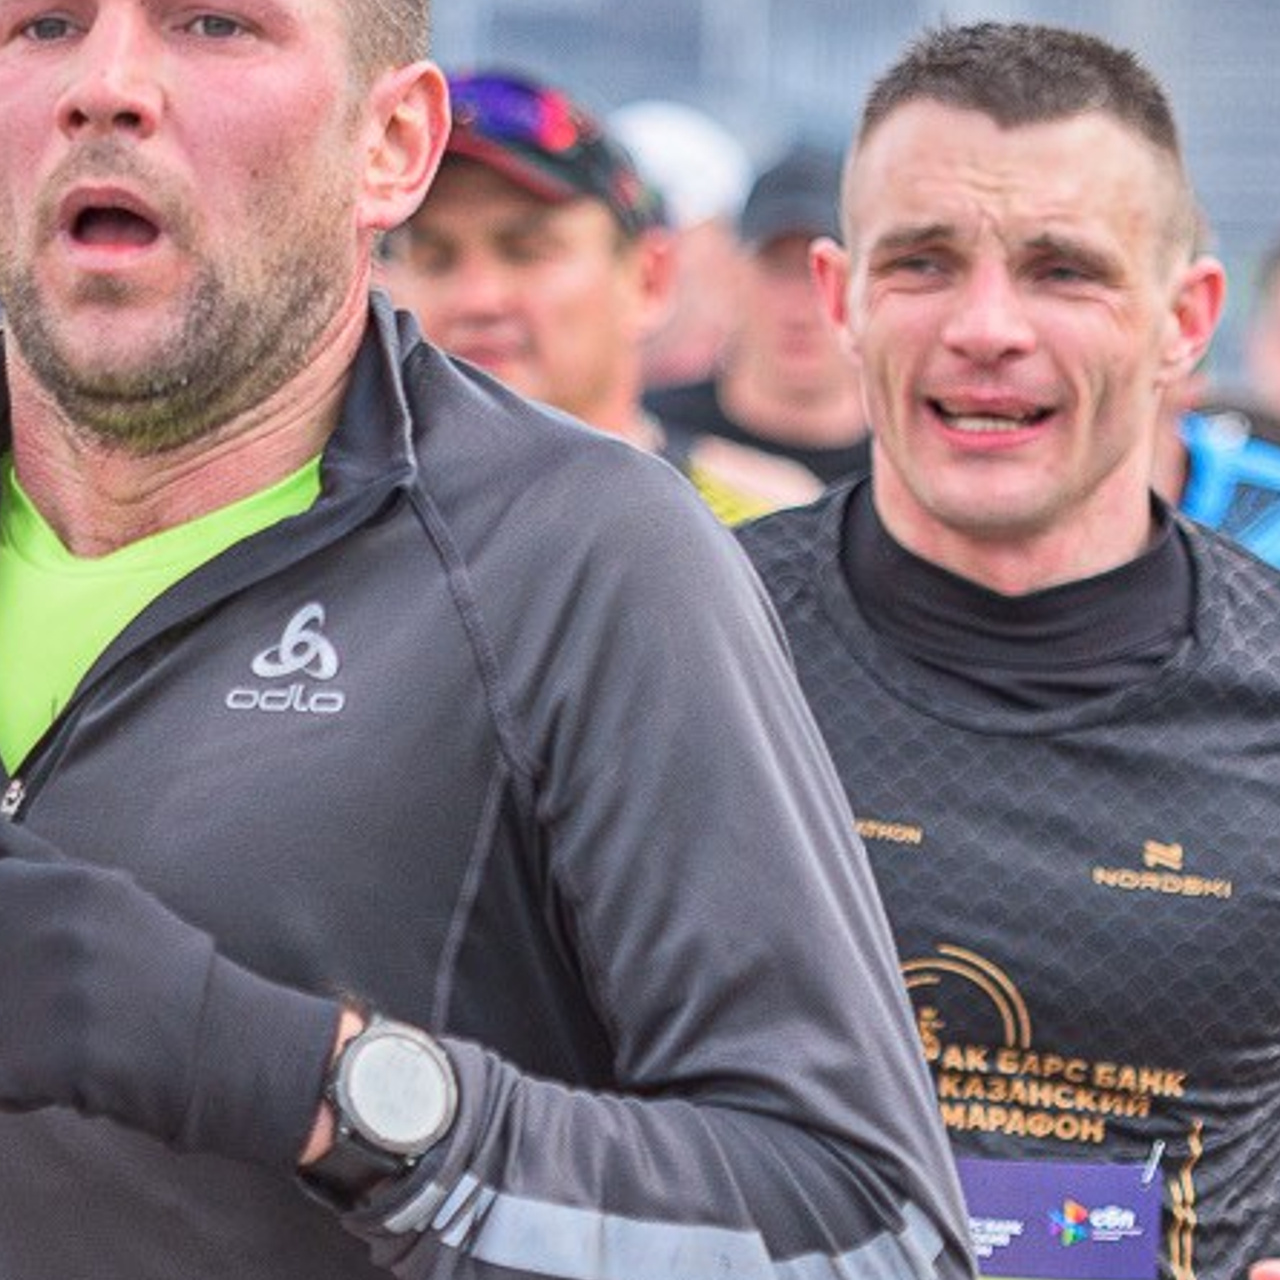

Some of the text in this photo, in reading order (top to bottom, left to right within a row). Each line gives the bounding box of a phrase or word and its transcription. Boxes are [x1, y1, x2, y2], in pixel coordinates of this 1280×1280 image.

[225, 683, 346, 713] odlo
[1092, 865, 1233, 898] NORDSKI
[942, 1044, 1188, 1098] АК БАРС БАНК
[938, 1073, 1152, 1118] КАЗАНСКИЙ
[939, 1102, 1106, 1144] МАРАФОН
